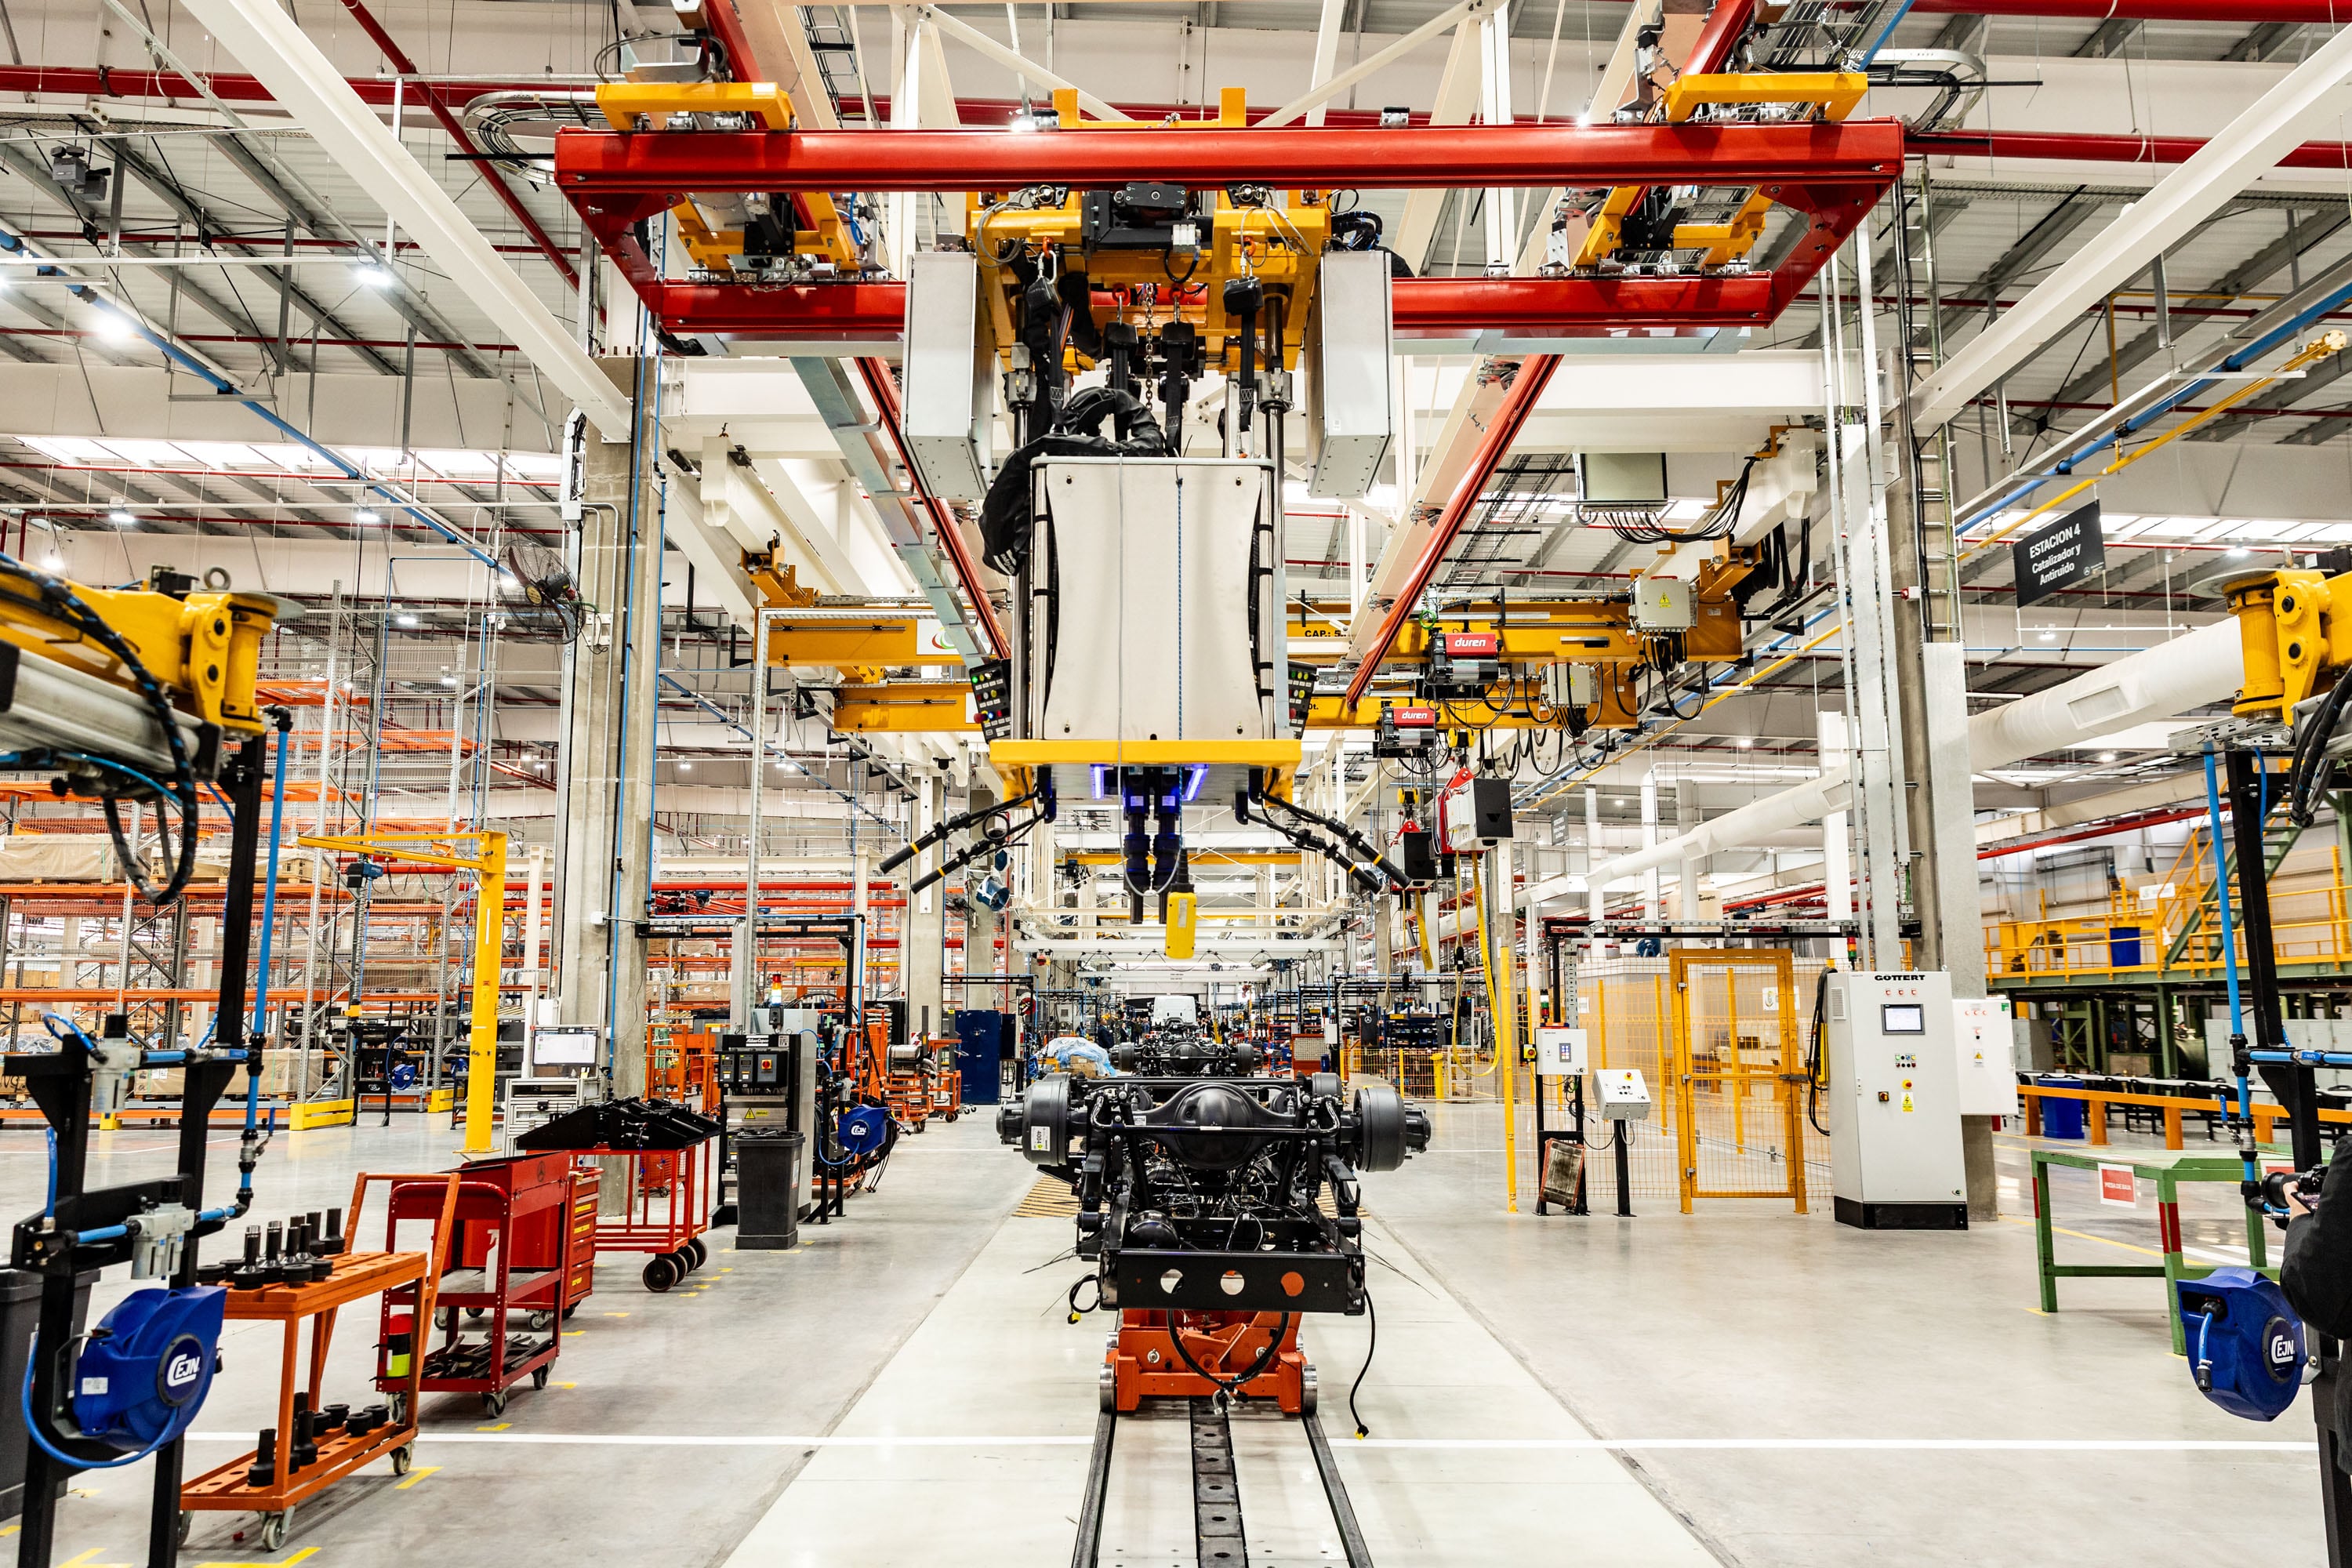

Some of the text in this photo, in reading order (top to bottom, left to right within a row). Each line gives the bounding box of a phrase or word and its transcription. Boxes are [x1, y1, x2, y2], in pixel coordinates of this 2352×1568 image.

[2030, 523, 2081, 559] ESTACION 4
[2032, 548, 2075, 574] Catalizador
[2075, 543, 2081, 557] y
[2040, 562, 2075, 586] Antiruido
[1454, 637, 1486, 647] duren
[851, 1125, 867, 1135] CEJN
[2271, 1334, 2294, 1364] CEJN
[167, 1353, 201, 1387] CEJN
